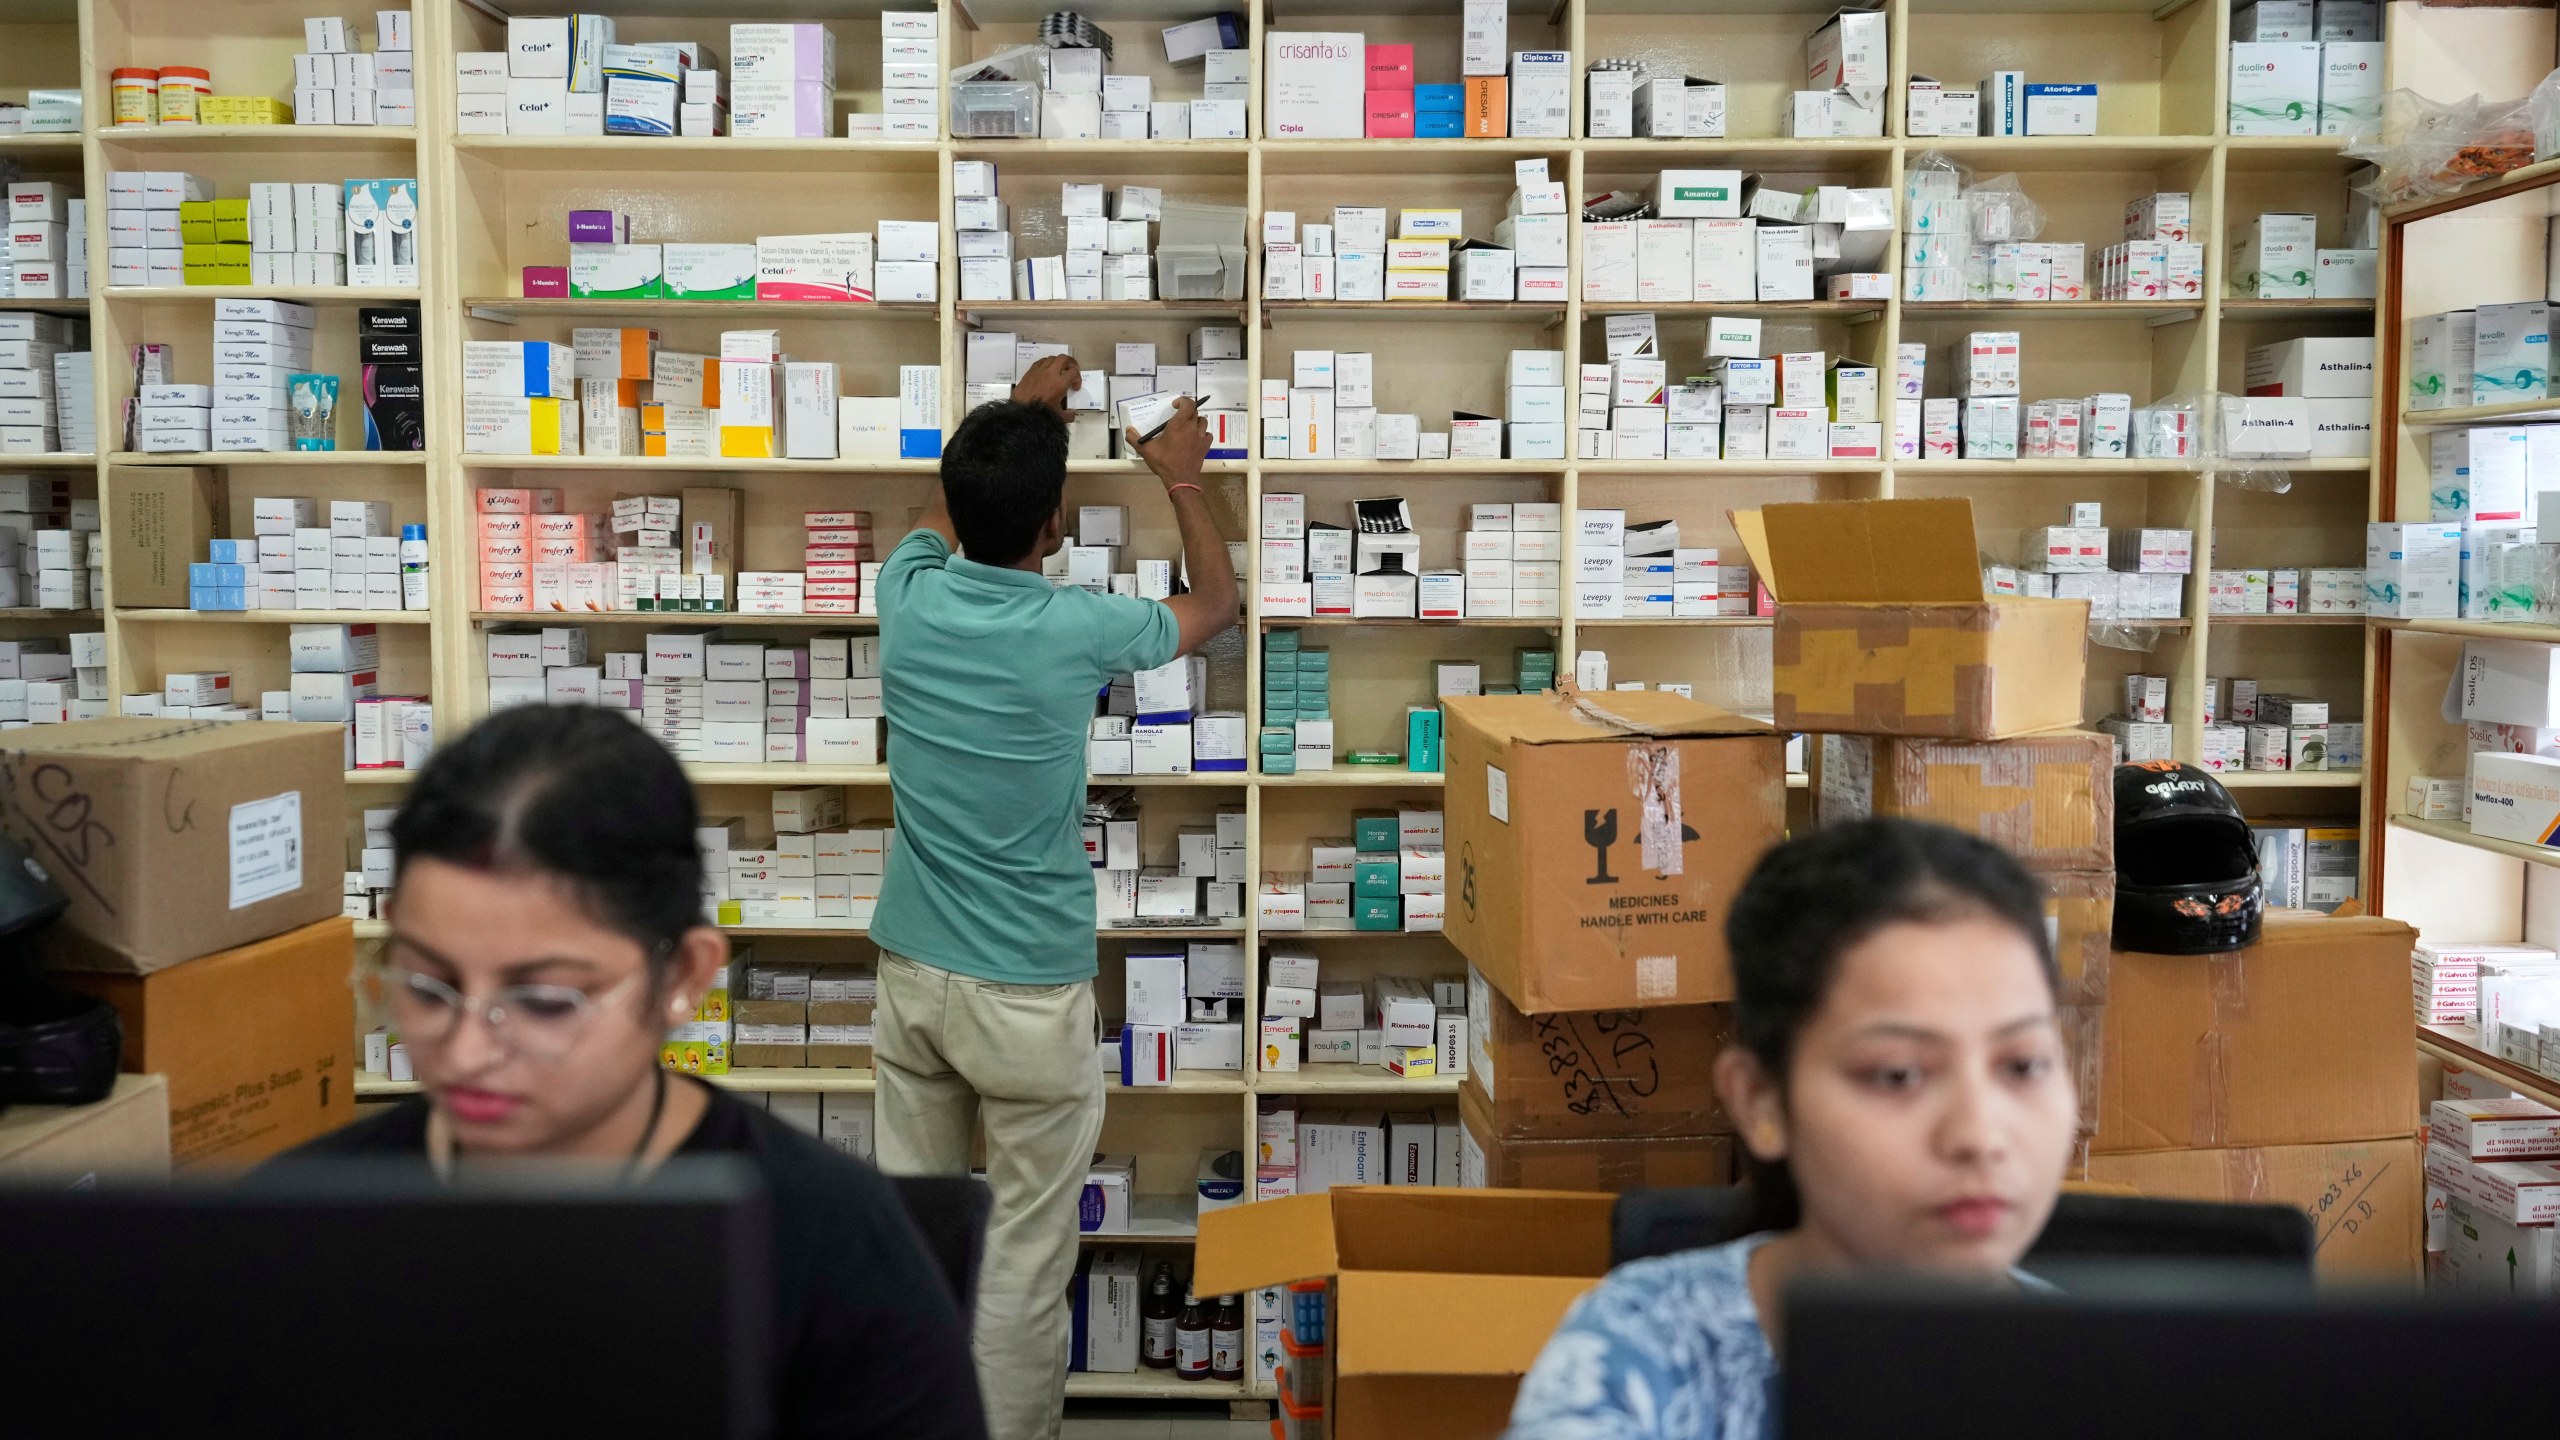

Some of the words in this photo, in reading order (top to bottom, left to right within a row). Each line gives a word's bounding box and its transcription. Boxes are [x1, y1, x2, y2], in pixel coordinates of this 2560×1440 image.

[1279, 41, 1332, 59] crisanta
[1337, 46, 1347, 58] LS
[1523, 54, 1563, 62] Ciplox-TZ
[2238, 64, 2265, 72] duolin
[2266, 63, 2274, 71] 3
[2330, 63, 2357, 71] duolin
[1280, 124, 1304, 133] Cipla
[1480, 119, 1487, 133] AM
[371, 316, 407, 325] Kerawash
[2479, 331, 2505, 340] levolin
[372, 344, 408, 352] Kerawash
[379, 385, 419, 393] Kerawash
[540, 522, 564, 531] Orofer
[1585, 521, 1613, 530] Levepsy
[541, 547, 564, 555] Orofer
[563, 546, 574, 554] XT
[1584, 557, 1613, 566] Levepsy
[490, 571, 512, 580] Orofer
[512, 570, 522, 578] XT
[490, 595, 513, 604] Orofer
[513, 594, 523, 603] XT
[1583, 594, 1611, 602] Levepsy
[2470, 656, 2477, 670] DS
[2468, 675, 2477, 706] Saslic
[2470, 728, 2492, 743] Saslic
[2145, 780, 2206, 794] GALAXY
[2475, 793, 2513, 806] Norflox-400
[2290, 843, 2301, 883] Zerostat
[1463, 858, 1474, 910] 25
[1609, 895, 1678, 909] MEDICINES
[1581, 916, 1632, 928] HANDLE
[1636, 914, 1667, 925] WITH
[1672, 911, 1707, 923] CARE
[1449, 1025, 1455, 1033] 35
[1315, 1042, 1339, 1050] rosulip
[235, 1079, 264, 1100] Plus
[2448, 1079, 2472, 1095] Advent
[1357, 1131, 1366, 1180] Entofoam
[1408, 1145, 1417, 1174] Esomac
